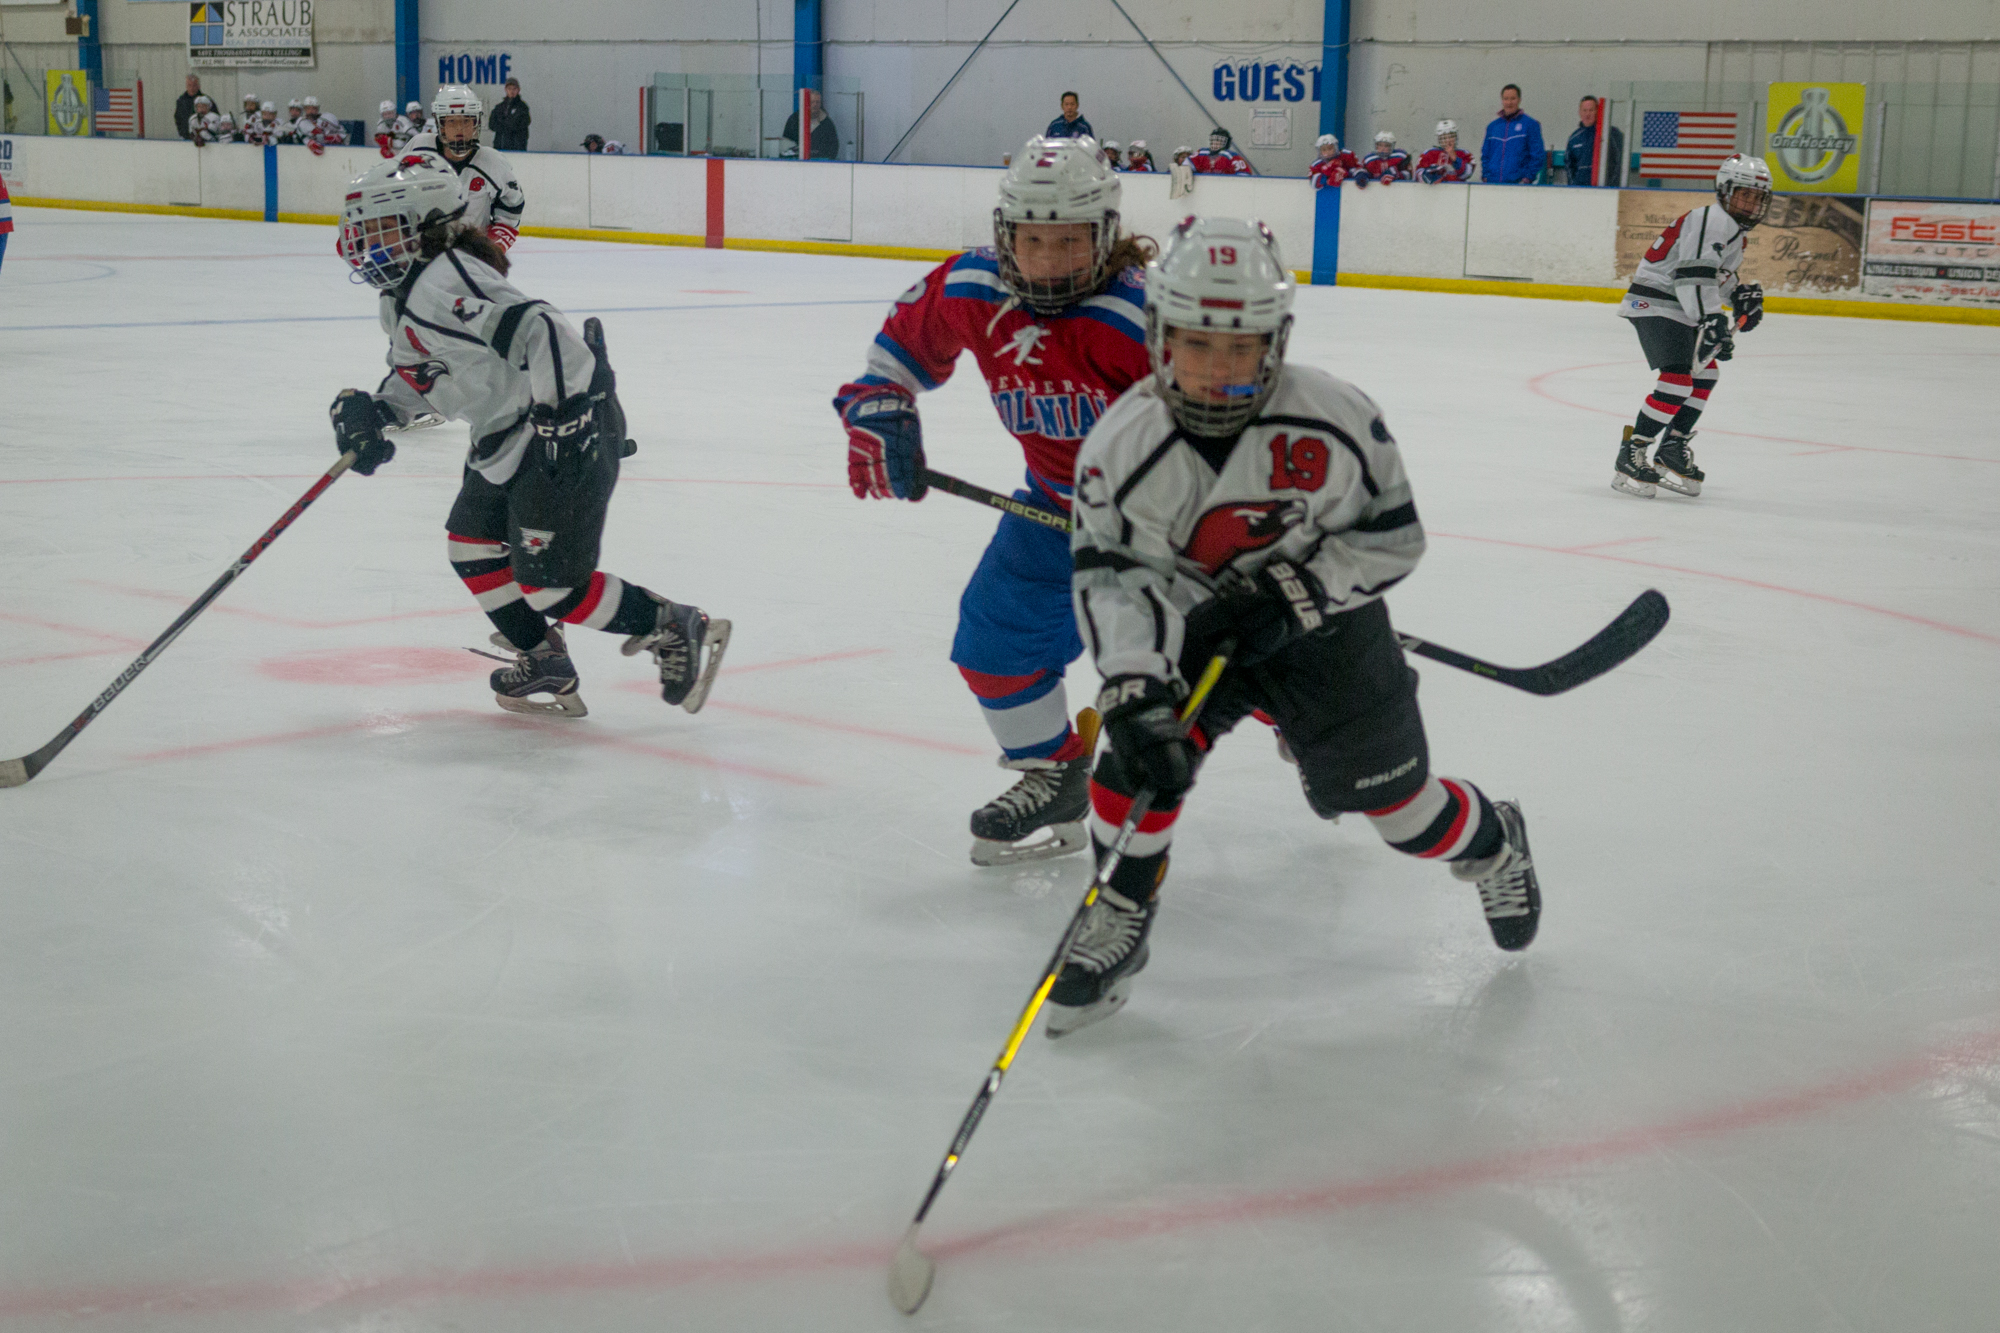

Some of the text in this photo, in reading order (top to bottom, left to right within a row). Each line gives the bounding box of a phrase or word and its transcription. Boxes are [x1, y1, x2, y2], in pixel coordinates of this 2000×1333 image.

[226, 1, 311, 26] STRAUB
[226, 28, 311, 37] & ASSOCIATES
[438, 53, 511, 84] HOME
[1772, 133, 1855, 154] OneHockey
[1207, 247, 1237, 265] 19
[536, 408, 593, 437] CCM
[1268, 433, 1329, 492] 19
[1355, 756, 1418, 790] BAUER
